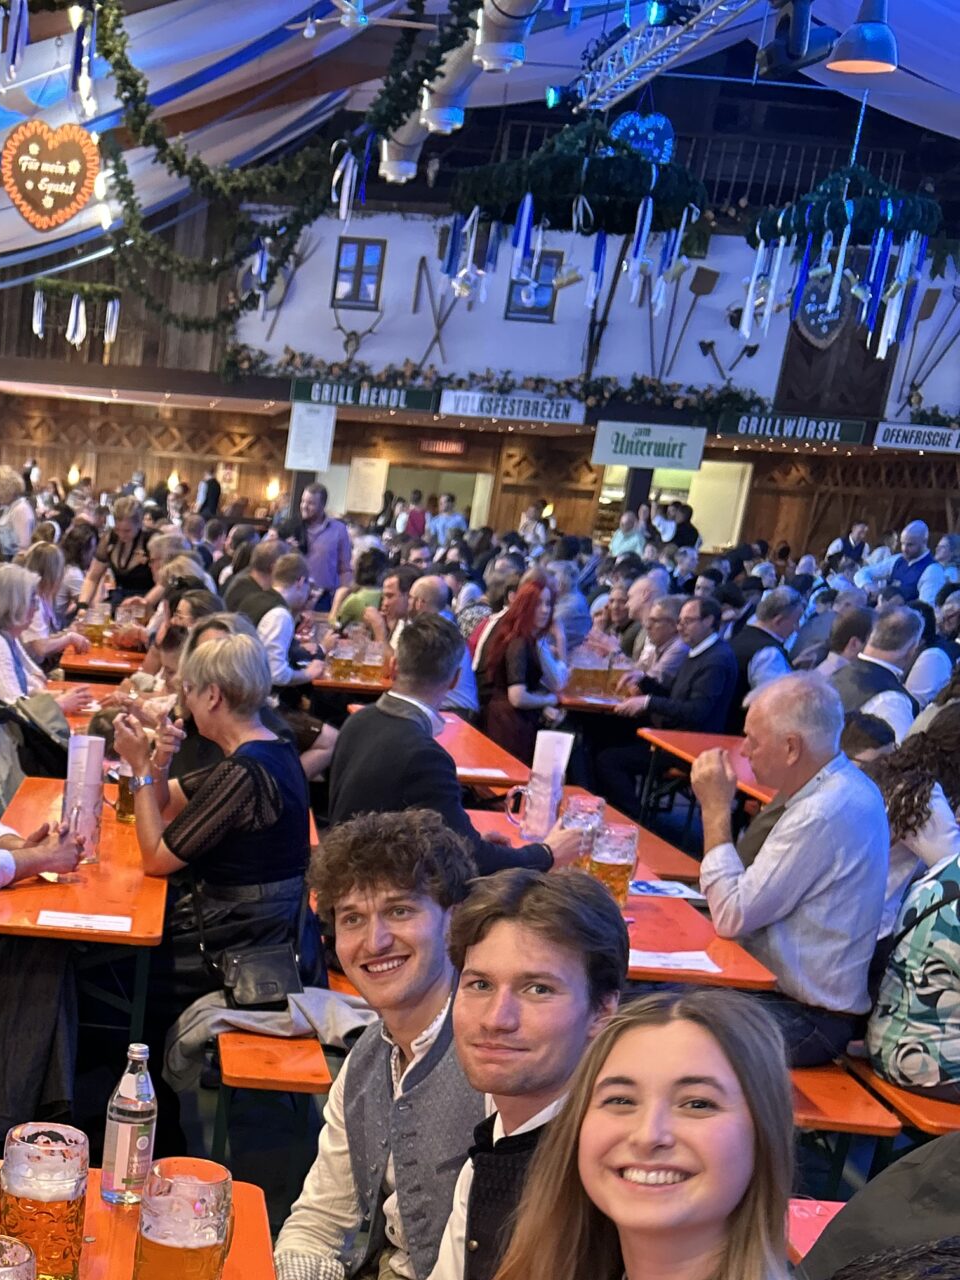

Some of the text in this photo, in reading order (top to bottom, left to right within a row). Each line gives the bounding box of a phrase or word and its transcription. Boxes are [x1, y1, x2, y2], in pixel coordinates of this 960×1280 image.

[311, 383, 407, 408] GRILL HENDL
[454, 395, 571, 419] VOLKSFESTBREZEN
[738, 416, 840, 440] GRILLWÜRSTL
[882, 428, 953, 448] OFENFRISCHE
[611, 432, 687, 459] Unterwirt
